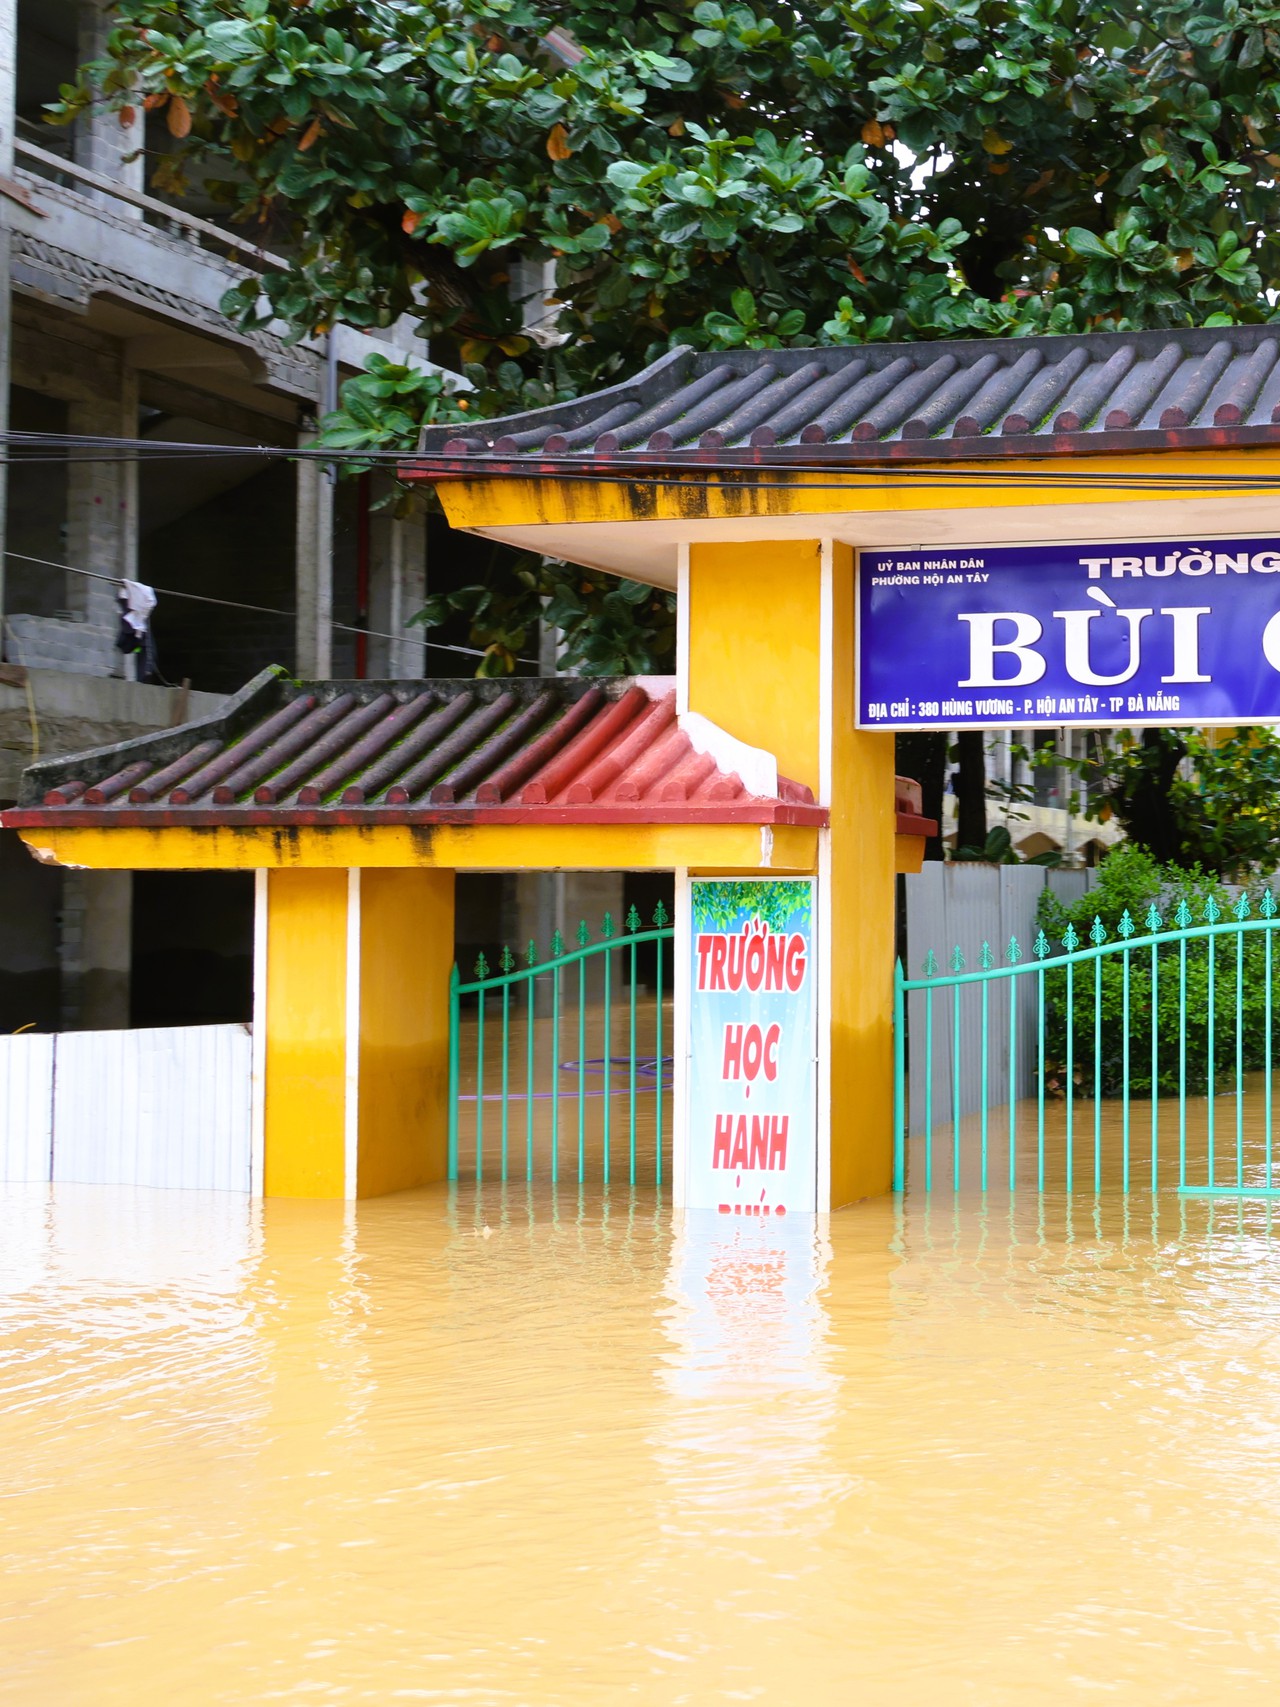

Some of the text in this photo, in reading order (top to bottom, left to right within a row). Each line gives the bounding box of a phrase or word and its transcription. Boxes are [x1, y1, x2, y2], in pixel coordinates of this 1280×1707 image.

[872, 572, 990, 587] PHƯỜNG HỘI AN TÂY
[878, 558, 985, 572] UỶ BAN NHÂN DÂN
[957, 586, 1212, 688] BÙI
[868, 702, 888, 721] ĐỊA
[890, 697, 910, 718] CHỈ
[918, 701, 938, 717] 380
[942, 698, 973, 716] HÙNG
[975, 698, 1014, 716] VƯƠNG
[1024, 699, 1034, 715] P.
[1036, 695, 1056, 717] HỘI
[1058, 698, 1076, 714] AN
[1077, 694, 1099, 713] TÂY
[1109, 697, 1124, 712] TP
[1127, 693, 1146, 712] ĐÀ
[1147, 690, 1180, 712] NẴNG
[697, 916, 807, 993] TRƯỜNG
[722, 1023, 781, 1100] HỌC
[711, 1113, 790, 1189] HẠNH
